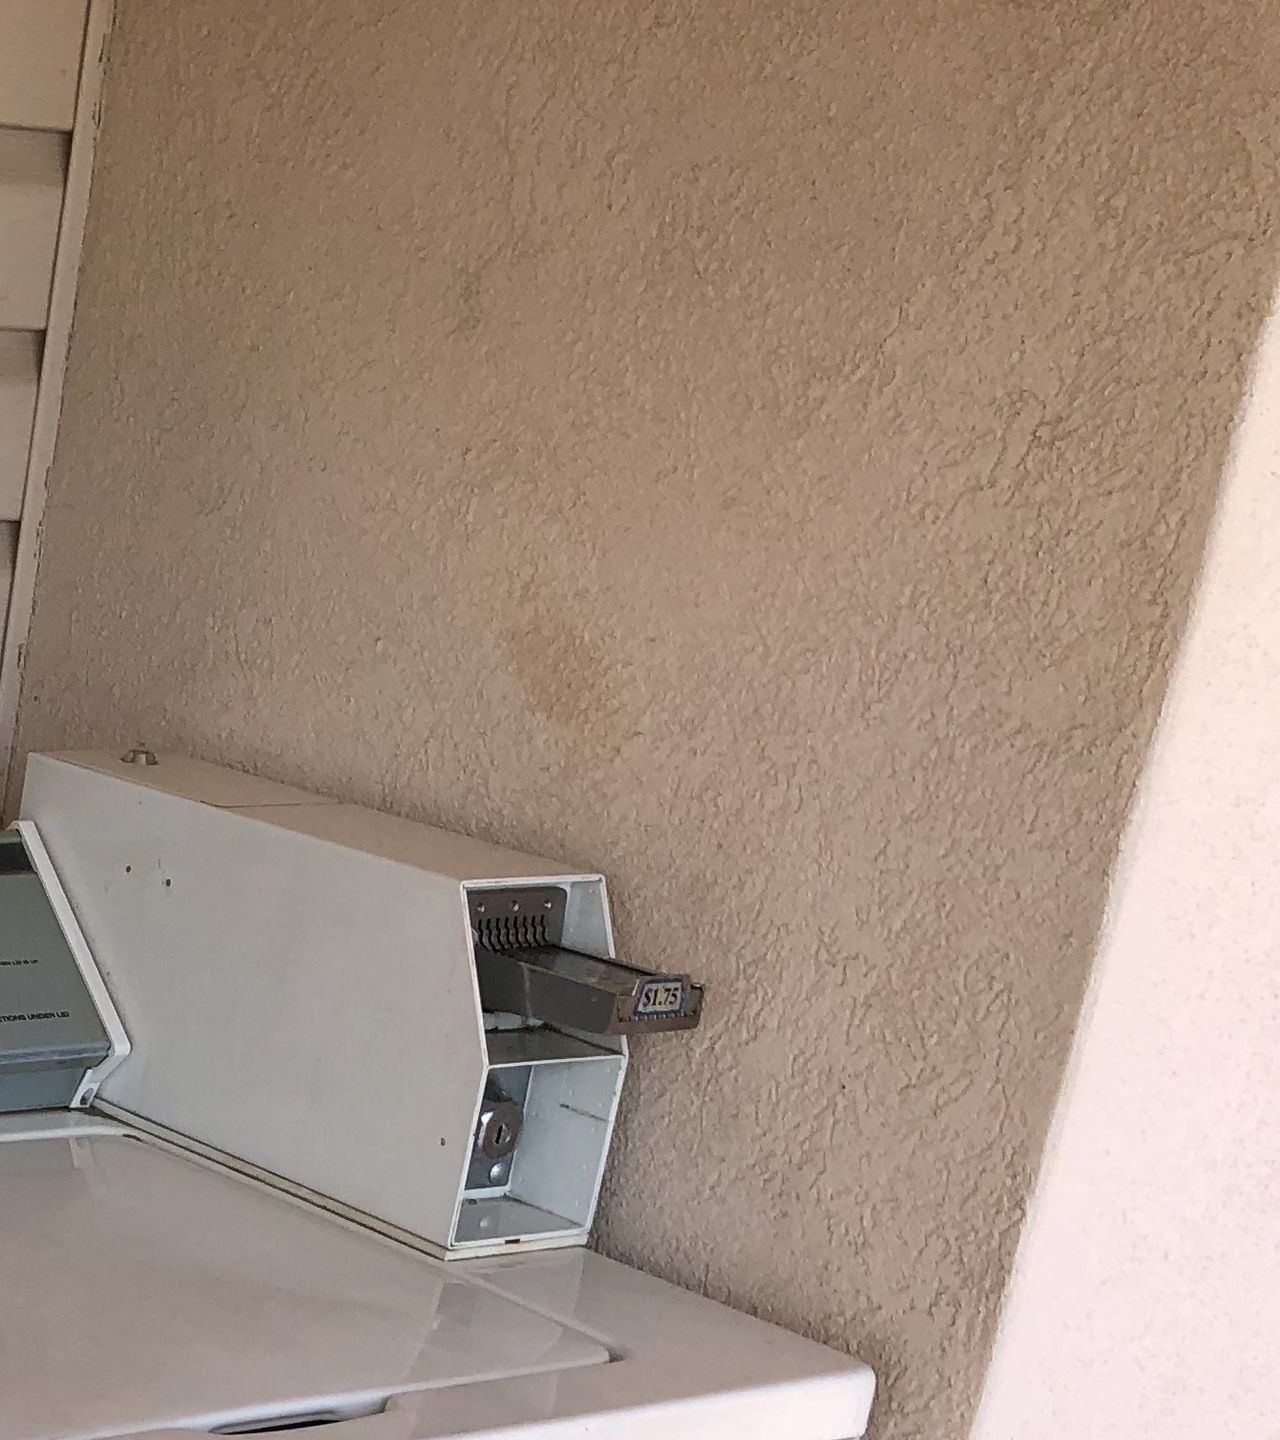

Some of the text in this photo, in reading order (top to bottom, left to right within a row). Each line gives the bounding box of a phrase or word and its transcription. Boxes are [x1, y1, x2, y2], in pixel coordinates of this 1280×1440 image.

[642, 987, 679, 1009] $1.75
[27, 1012, 56, 1021] UNDER
[56, 1010, 70, 1018] LID
